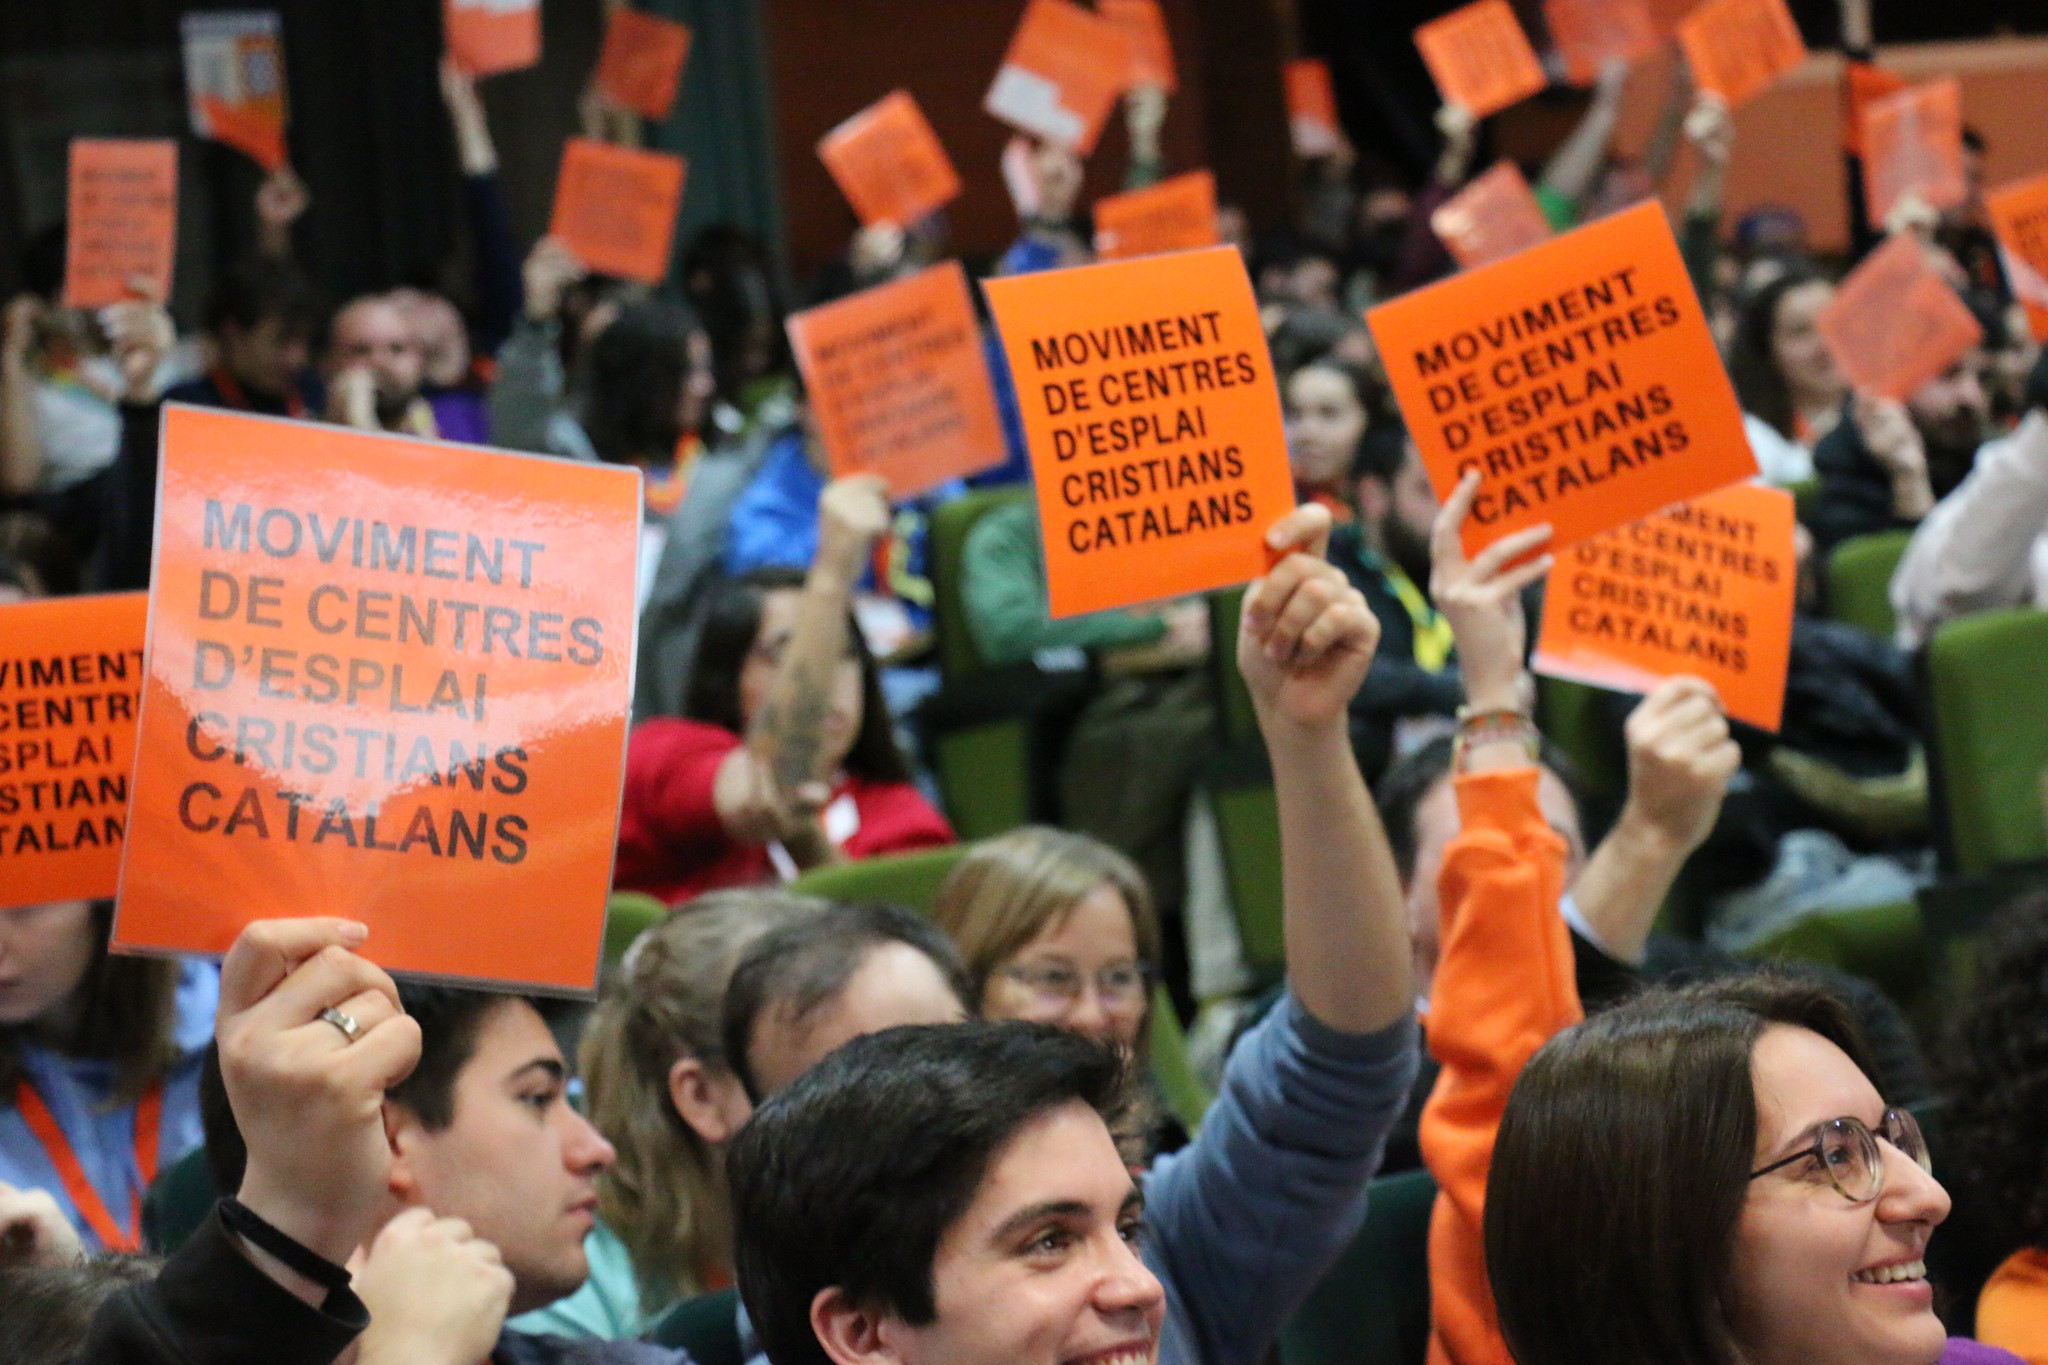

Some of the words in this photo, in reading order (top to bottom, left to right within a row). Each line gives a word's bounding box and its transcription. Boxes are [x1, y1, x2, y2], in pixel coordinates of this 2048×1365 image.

[1031, 312, 1221, 371] MOVIMENT
[1414, 267, 1638, 377] MOVIMENT
[1428, 373, 1484, 416] DE
[1491, 295, 1680, 389] CENTRES
[1043, 379, 1090, 416] DE
[1100, 352, 1257, 406] CENTRES
[1442, 360, 1624, 452] D'ESPLAI
[1053, 406, 1207, 462] D'ESPLAI
[1471, 421, 1690, 525] CATALANS
[1062, 446, 1244, 508] CRISTIANS
[203, 500, 545, 588] MOVIMENT
[1069, 490, 1253, 554] CATALANS
[198, 571, 284, 627] DE
[307, 584, 605, 667] CENTRES
[1569, 605, 1748, 674] CATALANS
[1574, 571, 1748, 638] CRISTIANS
[186, 713, 529, 796] CRISTIANS
[178, 781, 529, 865] CATALANS
